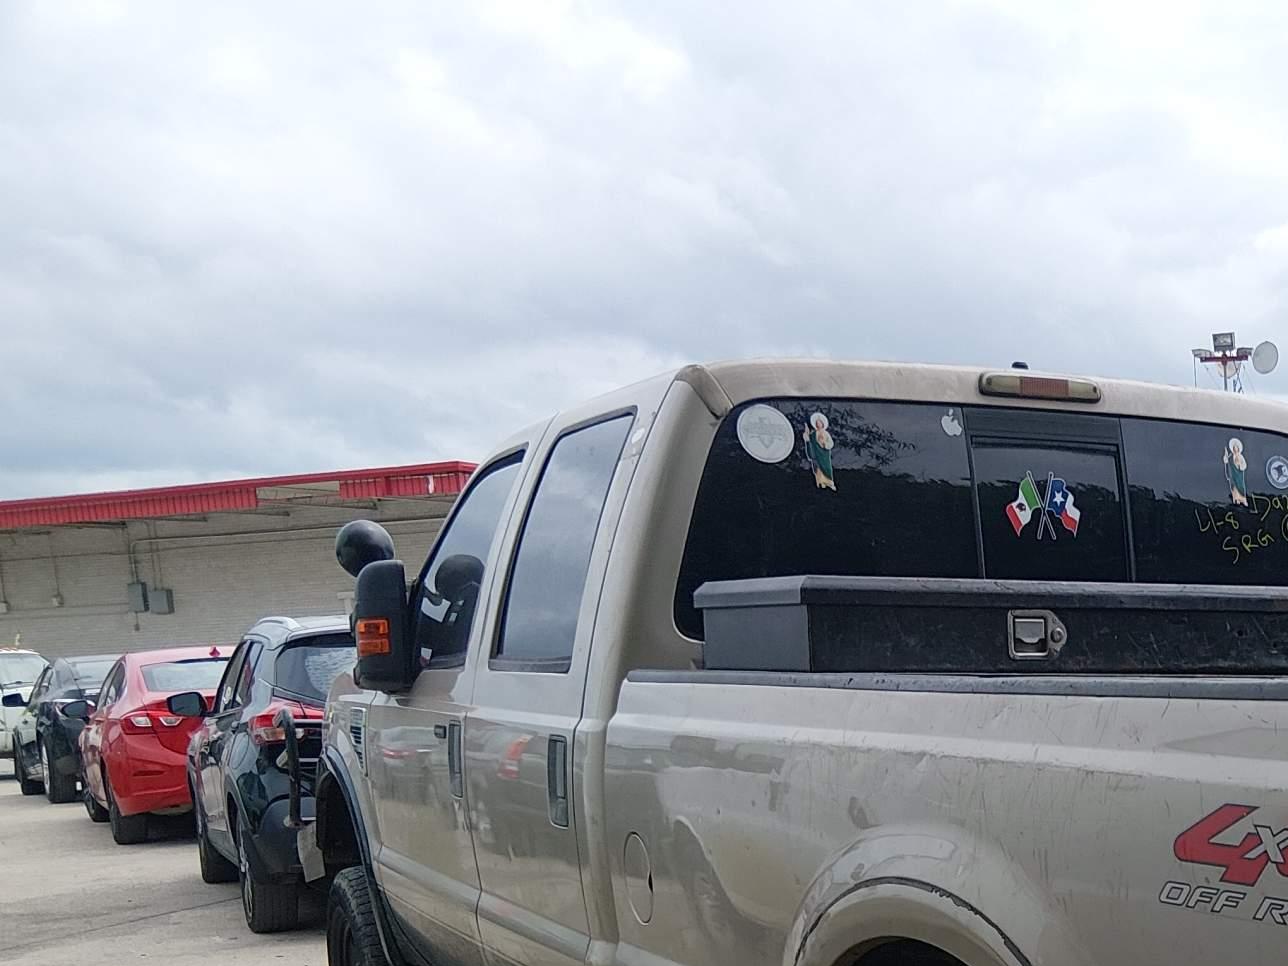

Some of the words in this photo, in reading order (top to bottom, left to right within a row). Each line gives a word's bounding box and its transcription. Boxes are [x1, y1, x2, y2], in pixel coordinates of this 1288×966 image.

[1195, 507, 1240, 535] 4-8
[1222, 528, 1275, 564] SRG
[1159, 880, 1247, 913] OFF
